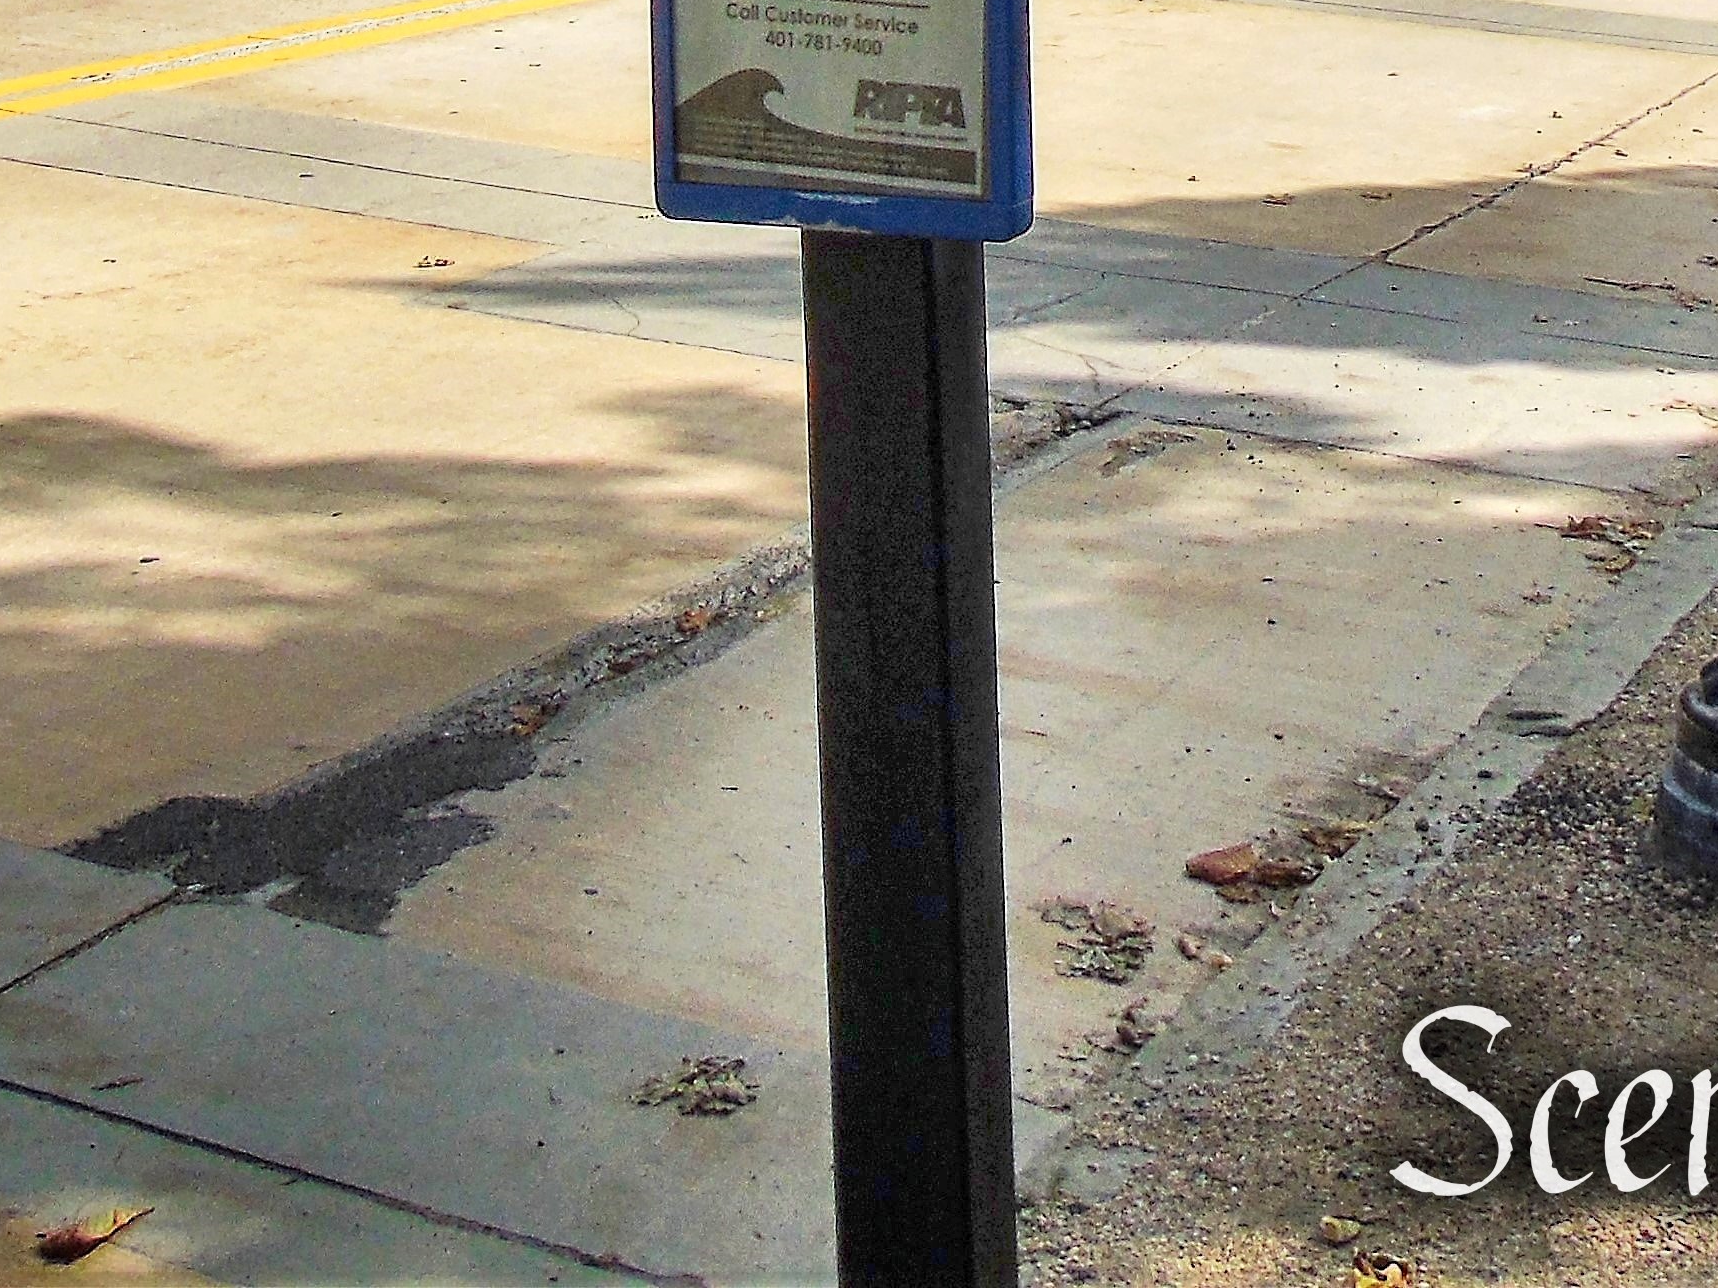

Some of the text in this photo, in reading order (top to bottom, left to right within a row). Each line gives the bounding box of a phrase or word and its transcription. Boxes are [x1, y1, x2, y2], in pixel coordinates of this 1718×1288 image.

[725, 2, 920, 35] Call Customer Service
[765, 29, 884, 56] 401-781-9400
[853, 78, 966, 129] RIPTA
